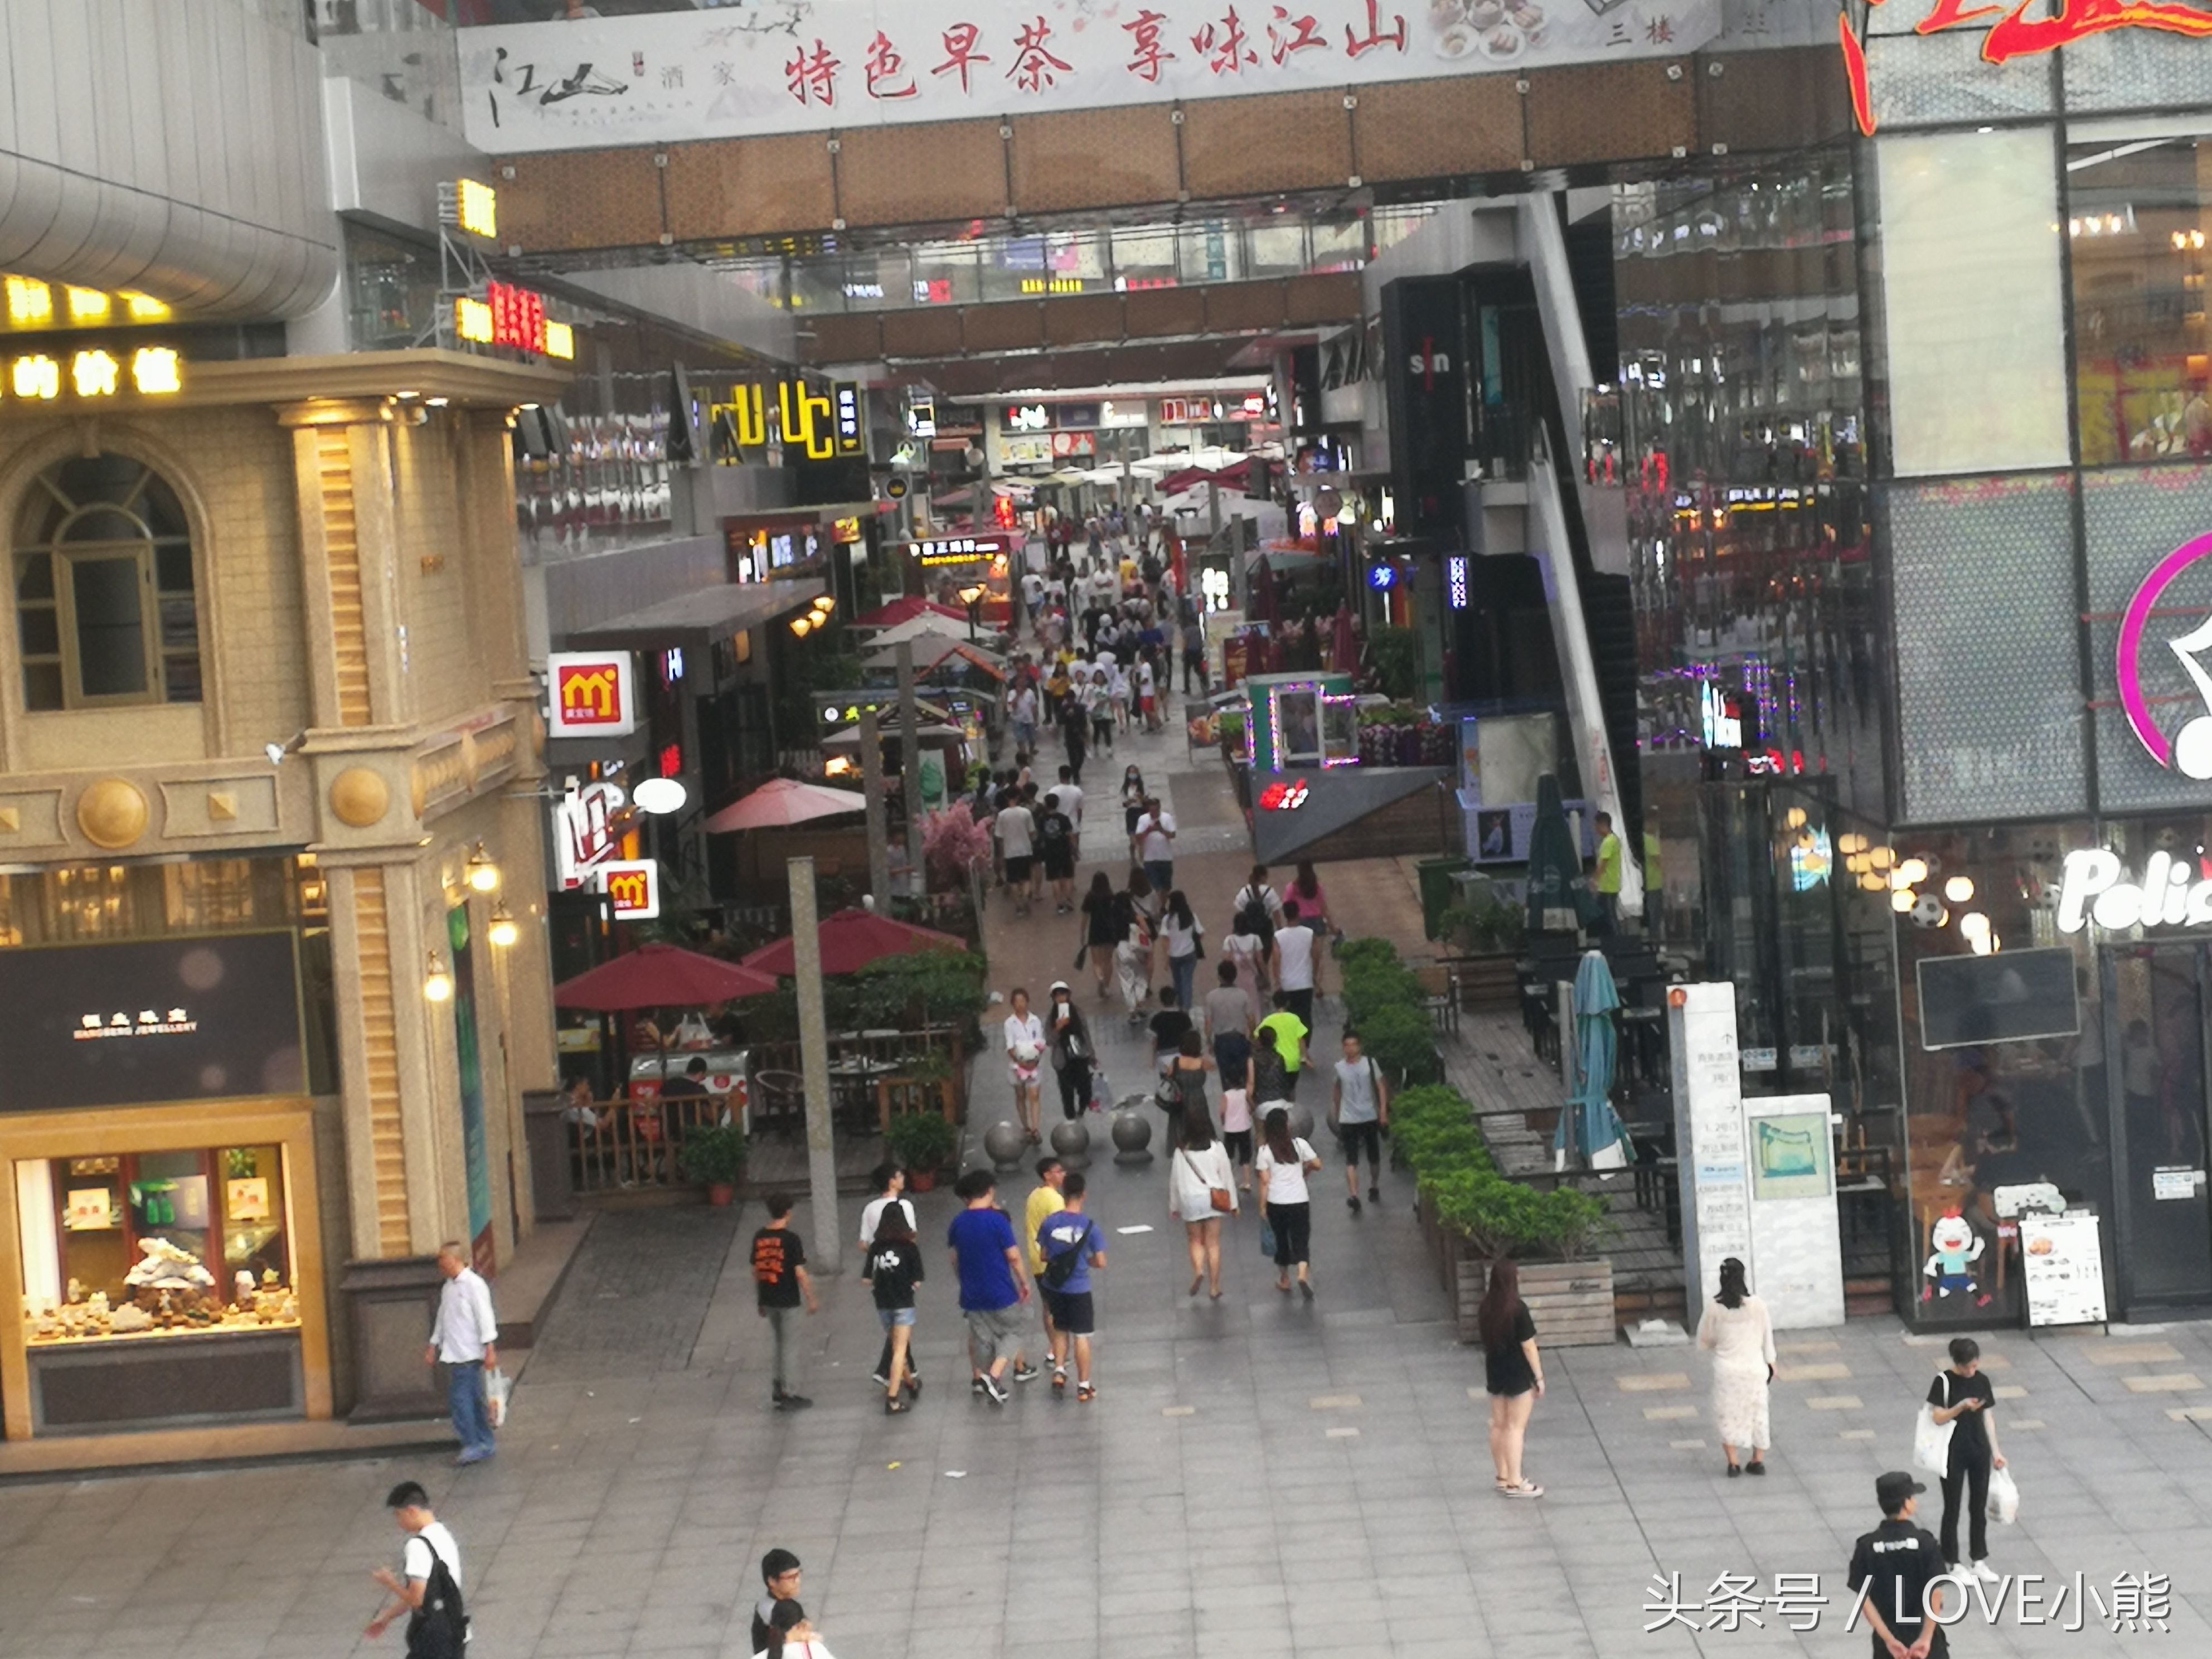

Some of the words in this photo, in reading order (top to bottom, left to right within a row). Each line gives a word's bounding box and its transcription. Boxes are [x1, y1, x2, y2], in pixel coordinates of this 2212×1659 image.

[784, 15, 1073, 106] 特色早茶
[1122, 0, 1405, 83] 享味江山
[1607, 16, 1674, 46] 三楼
